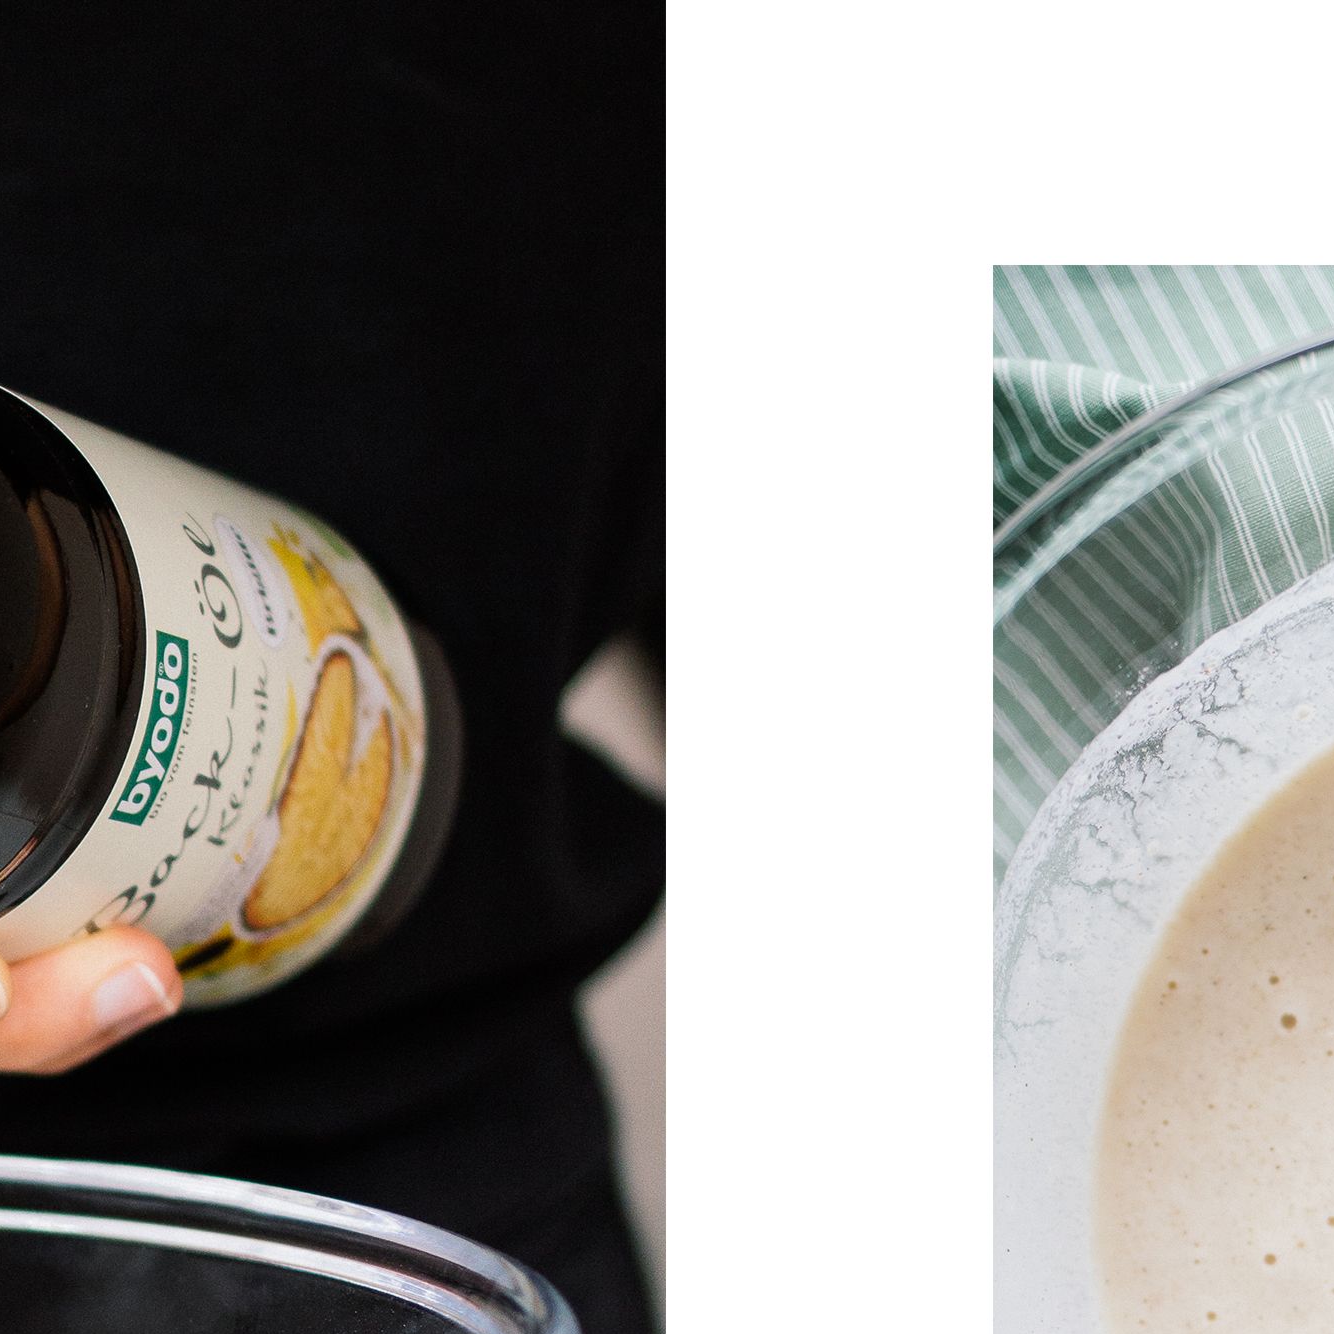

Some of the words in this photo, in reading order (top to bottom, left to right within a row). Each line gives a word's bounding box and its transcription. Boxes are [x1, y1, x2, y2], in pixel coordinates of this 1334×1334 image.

[149, 791, 168, 819] bio
[168, 745, 186, 784] vom
[182, 653, 198, 736] feinsten
[207, 658, 269, 847] Klassik
